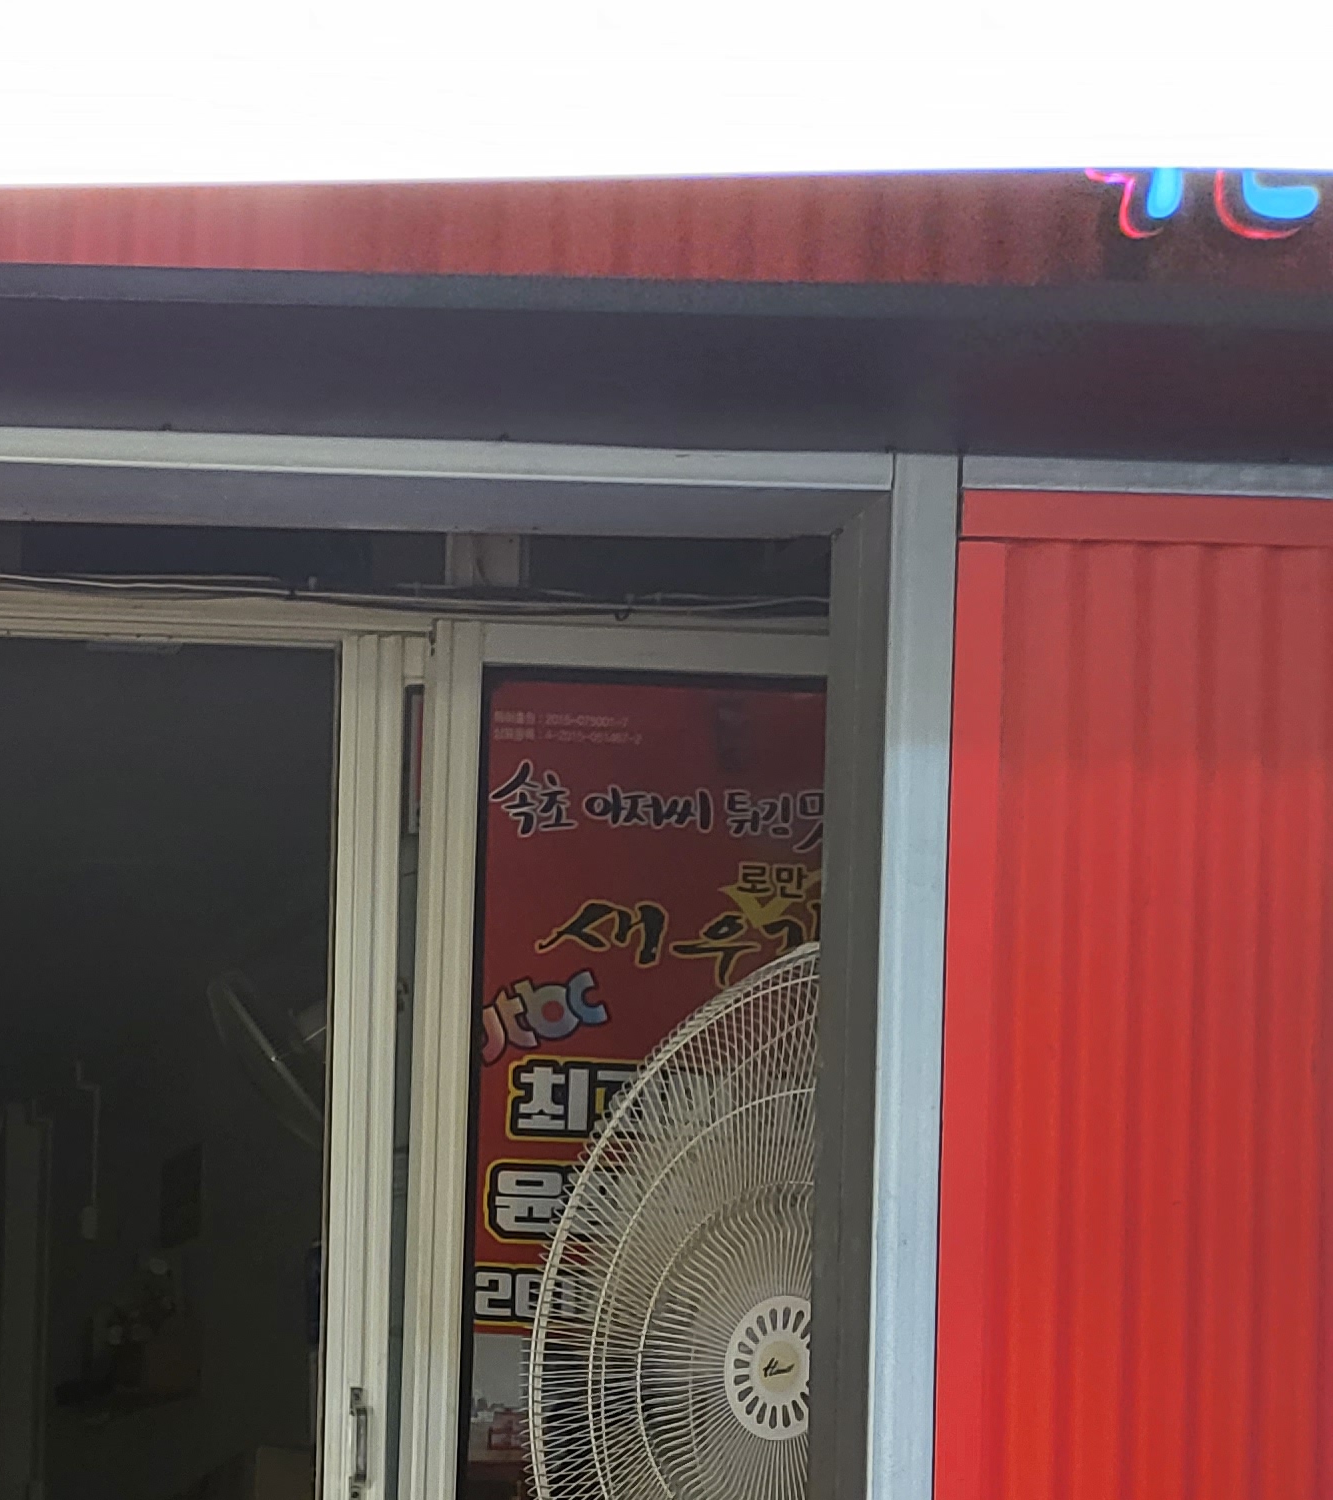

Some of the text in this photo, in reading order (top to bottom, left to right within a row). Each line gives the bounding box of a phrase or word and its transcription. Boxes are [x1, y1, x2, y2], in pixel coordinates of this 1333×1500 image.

[491, 760, 577, 837] 속초
[584, 784, 712, 832] 아저씨
[737, 862, 808, 899] 로만
